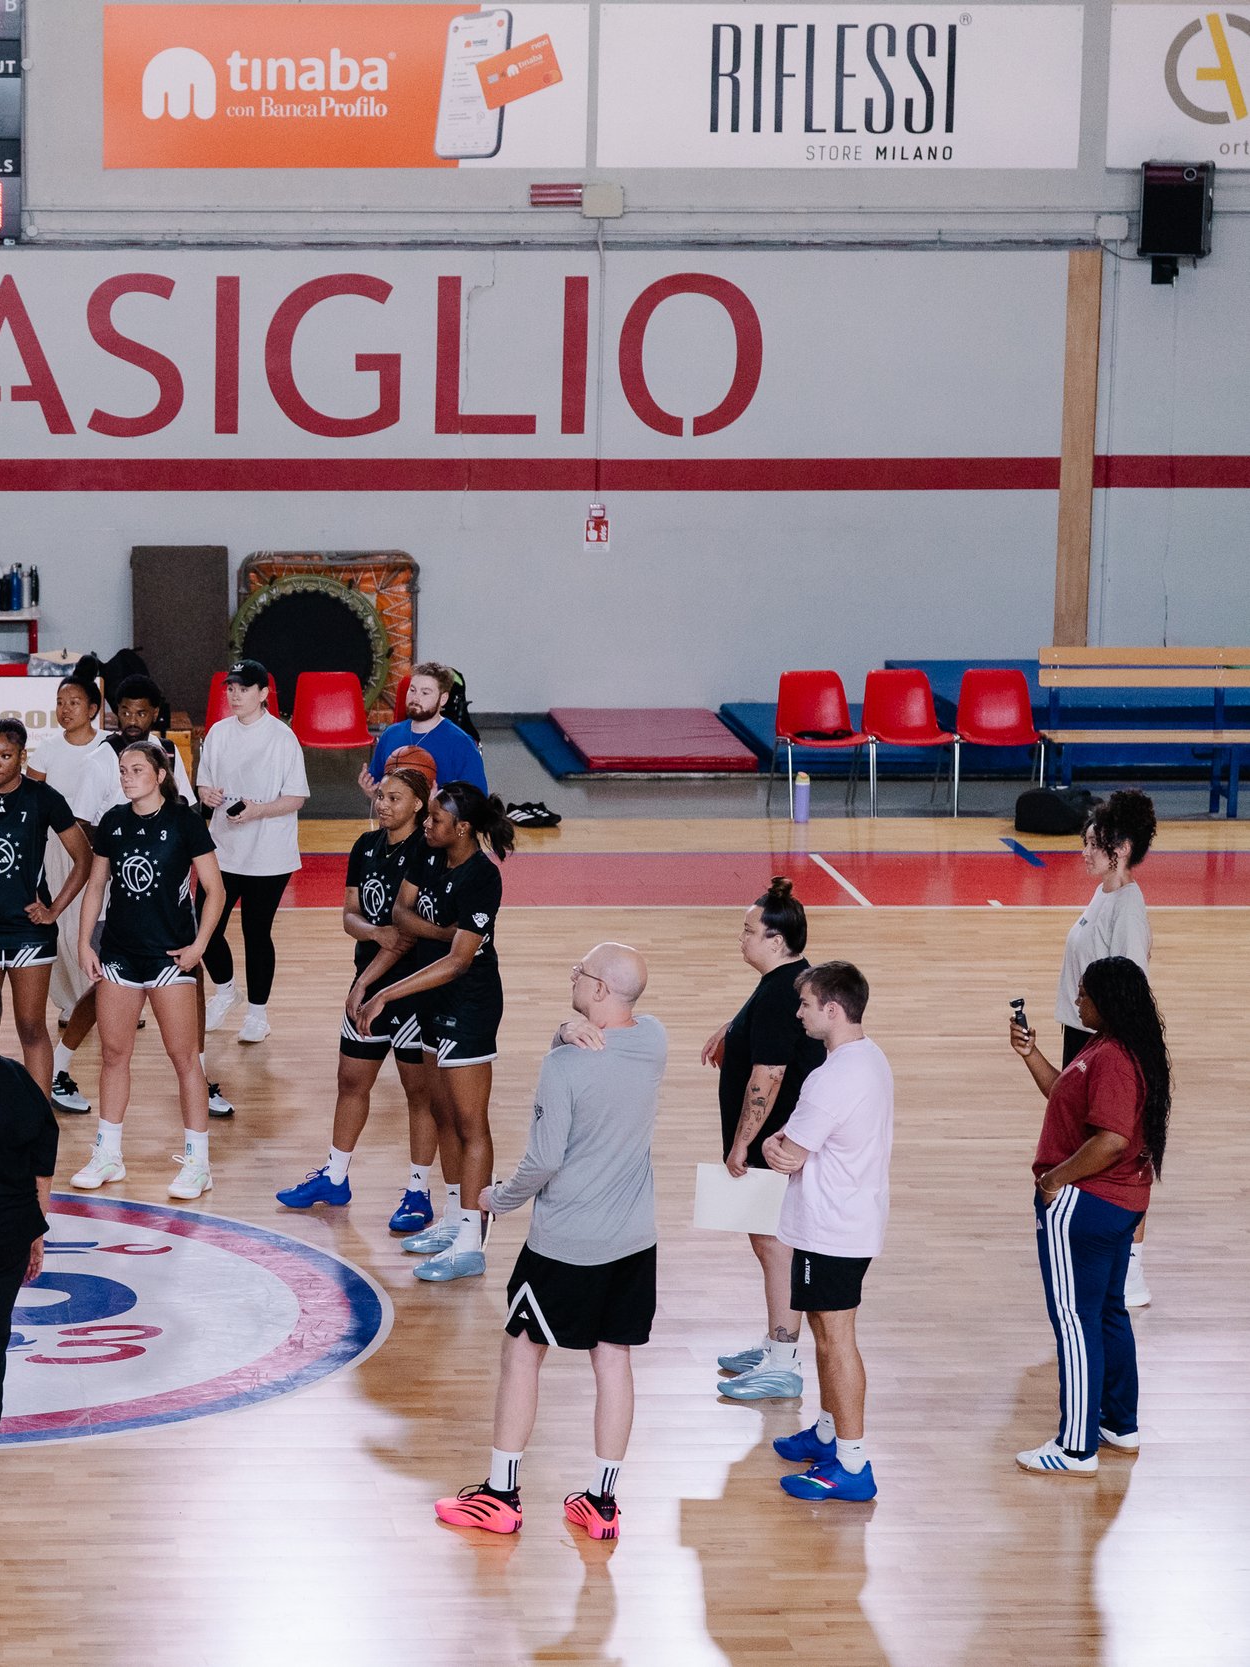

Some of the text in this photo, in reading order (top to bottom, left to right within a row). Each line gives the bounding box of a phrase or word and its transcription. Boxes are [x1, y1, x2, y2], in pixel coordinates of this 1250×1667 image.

[226, 47, 389, 92] tinaba
[709, 23, 957, 134] RIFLESSI
[226, 105, 255, 117] con
[806, 145, 953, 161] STORE MILANO
[20, 811, 28, 823] 7
[160, 829, 168, 841] 3
[397, 855, 406, 866] 9
